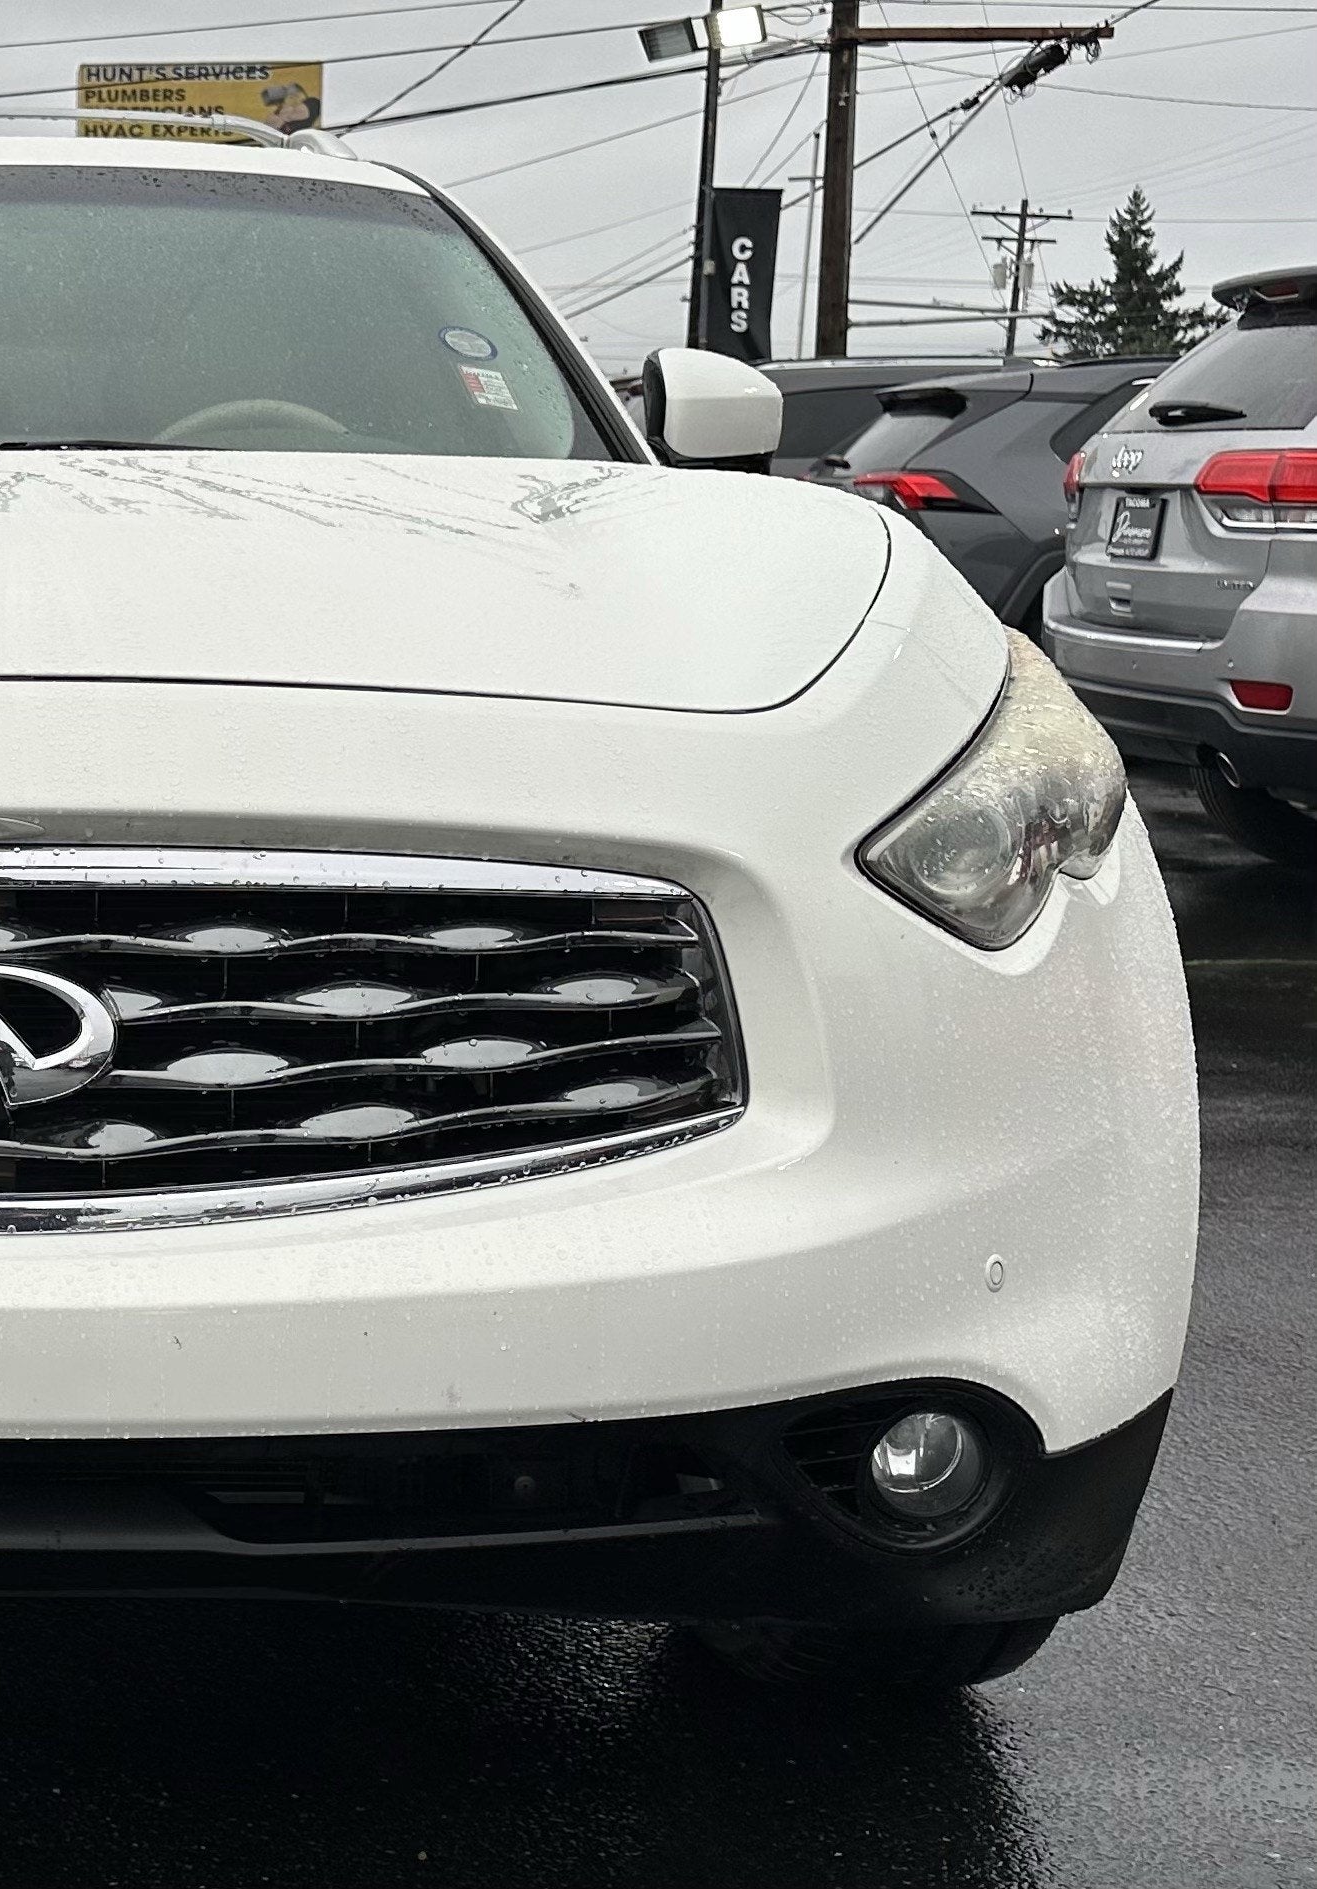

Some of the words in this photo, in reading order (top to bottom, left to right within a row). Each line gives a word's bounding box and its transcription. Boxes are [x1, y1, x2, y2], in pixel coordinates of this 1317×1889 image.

[87, 65, 167, 82] HUNT'S
[172, 65, 269, 80] SERVICES
[85, 88, 186, 103] PLUMBERS
[84, 123, 145, 137] HVAC
[730, 235, 754, 334] CARS
